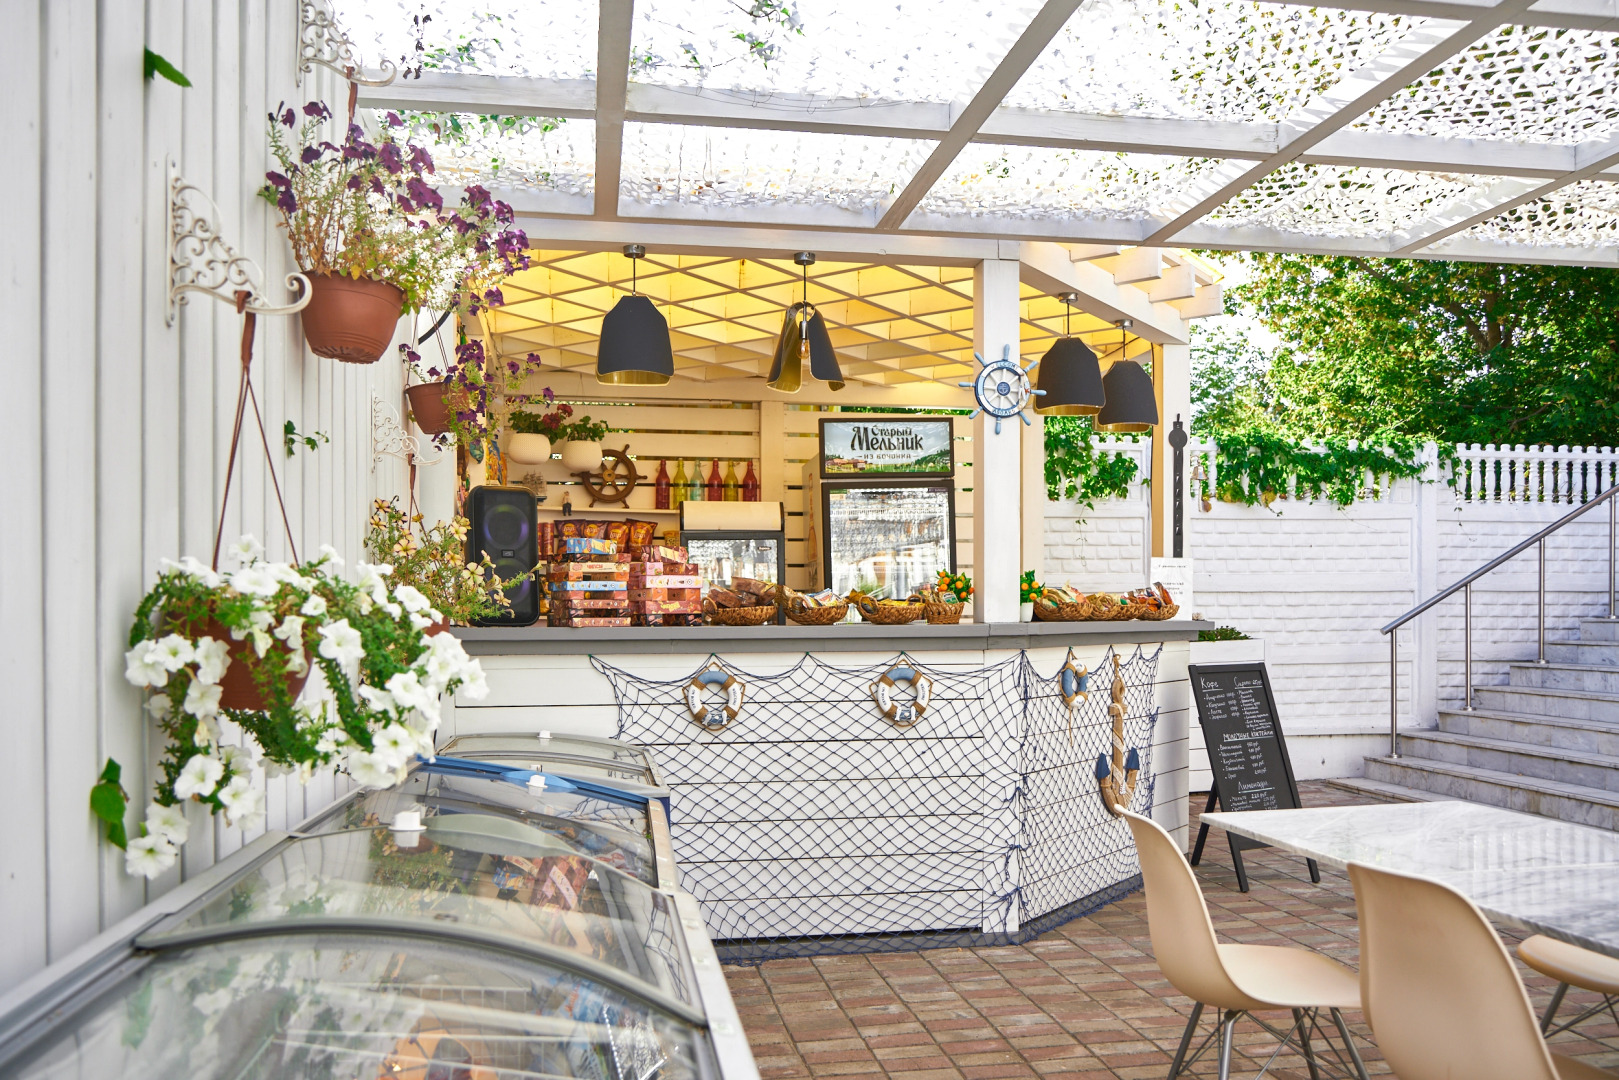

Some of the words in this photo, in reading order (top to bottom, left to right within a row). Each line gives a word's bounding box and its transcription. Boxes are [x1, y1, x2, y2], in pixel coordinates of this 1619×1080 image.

[871, 425, 912, 437] Старый
[851, 426, 924, 451] Мельник
[1200, 676, 1219, 689] Кофе
[1238, 781, 1268, 790] Лимонады
